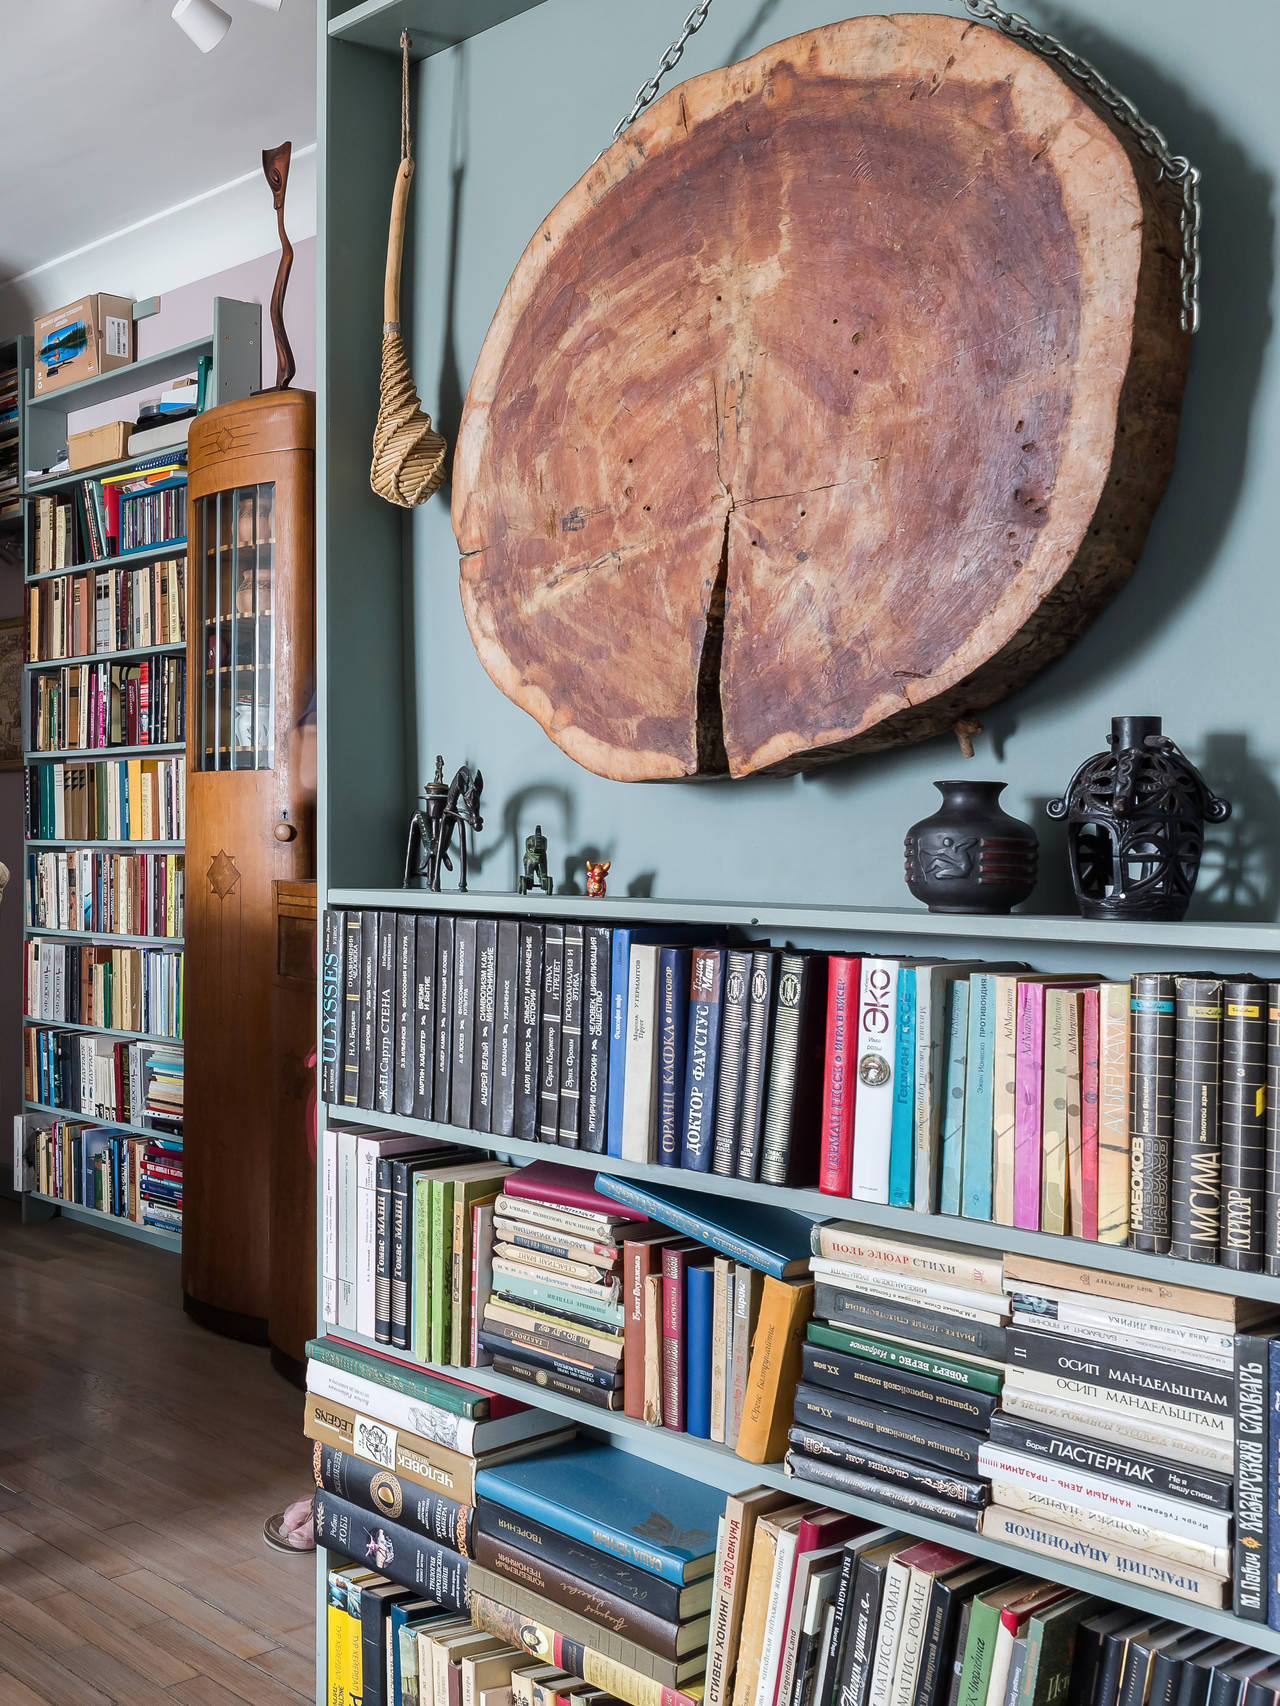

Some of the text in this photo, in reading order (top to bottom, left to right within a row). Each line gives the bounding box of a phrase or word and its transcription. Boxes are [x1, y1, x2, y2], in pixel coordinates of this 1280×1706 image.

[525, 935, 533, 987] НАЗНАЧЕНИЕ
[545, 964, 553, 993] СТРАХ
[552, 958, 560, 992] ТРЕПЕТ
[693, 957, 704, 992] Томас
[701, 957, 713, 992] Манн
[322, 952, 339, 1063] ULYSSES
[479, 950, 488, 1022] СИМВОЛИЗМ КАК
[486, 946, 494, 1023] МИРОПОНИМАНИЕ
[565, 957, 574, 1022] ПСИХОАНАЛИЗ
[572, 972, 580, 1001] ЭТИКА
[589, 936, 598, 1036] ЧЕЛОВЕК ЦИВИЛИЗАЦИЯ
[665, 966, 673, 1015] ПРИГОВОР
[862, 968, 891, 1035] ЭКО
[380, 988, 391, 1034] СТЕНА
[595, 990, 603, 1037] ОБЩЕСТВО
[613, 1009, 623, 1041] Философия
[833, 978, 846, 1053] ИГРА В БИСЕР
[978, 977, 988, 1039] ПРОТИВОЯДИЯ
[480, 1041, 489, 1106] АНДРЕЙ БЕЛЫЙ
[524, 1041, 532, 1073] ЯСПЕРС
[565, 1038, 576, 1088] Эрих Фромм
[897, 1047, 911, 1105] Герман
[976, 1042, 986, 1094] Эжен Ионеско
[418, 1068, 426, 1096] МАРТИН
[588, 1053, 598, 1133] ПИТИРИМ СОРОКИН
[662, 1024, 675, 1153] ФРАНЦ КАФКА
[686, 1005, 709, 1156] ДОКТОР ФАУСТУС
[826, 1066, 845, 1175] ГЕРМАН ГЕССЕ
[1199, 1084, 1208, 1142] Золотой храм
[395, 1174, 403, 1184] 2
[1130, 1137, 1145, 1231] НАБОКОВ
[1190, 1152, 1221, 1241] МИСИМА
[375, 1197, 386, 1236] МАНН
[394, 1199, 404, 1240] МАНН
[1226, 1190, 1252, 1250] КОРТАСАР
[831, 1242, 957, 1275] ПОЛЬ ЭЛЮАР СТИХИ
[631, 1255, 643, 1321] Булат Окуджава
[844, 1303, 976, 1343] РИЛЬКЕ НОВЫЕ СТИХОТВОРЕНИЯ
[1072, 1326, 1118, 1342] БАЛЬМОНТ
[1107, 1315, 1210, 1344] Анна Ахматова ЛИРИКА
[812, 1360, 827, 1371] век
[849, 1340, 969, 1383] РОБЕРТ БЕРНС Избранное
[1056, 1356, 1229, 1408] ОСИП МАНДЕЛЬШТАМ
[806, 1403, 821, 1413] век
[853, 1372, 980, 1416] Страницы европейской поэзии
[1055, 1378, 1226, 1432] ОСИП МАНДЕЛЬШТАМ
[314, 1407, 354, 1436] LEGENS
[846, 1415, 971, 1461] Страницы европейской поэзии
[396, 1453, 455, 1489] ЧЕЛОВЕК
[868, 1460, 910, 1480] СИМФОНИЯ
[1025, 1439, 1156, 1484] Борис ПАСТЕРНАК
[1237, 1362, 1263, 1534] ХАЗАРСКИЙ СЛОВАРЬ
[999, 1462, 1210, 1531] Игорь Губерман КАЖДЫЙ ДЕНЬ ПРАЗДНИК
[1167, 1473, 1181, 1483] Не
[1167, 1482, 1190, 1496] пишу
[330, 1513, 340, 1538] Робин
[338, 1514, 349, 1545] ХОББ
[434, 1500, 444, 1540] ХРОНИКИ
[498, 1518, 544, 1546] ТВОРЕНИЯ
[1028, 1492, 1150, 1538] ХРОНИКИ НАРНИИ
[435, 1550, 444, 1597] КОРОЛЕВСКОМ
[497, 1552, 542, 1580] ТРЕНОЖНИК
[592, 1530, 663, 1572] САША ЧЕРНЫЙ
[722, 1519, 741, 1590] за 30 секунд
[1004, 1520, 1199, 1593] ИРАКЛИЙ АНДРОНИКОВ
[441, 1565, 449, 1594] УБИЙЦЕ
[495, 1560, 545, 1589] КОЛЕБЛЕМЫЙ
[833, 1556, 852, 1622] RENÉ MAGRITTE
[760, 1548, 786, 1682] КИТАЙСКАЯ ПЕЙЗАЖНАЯ ЖИВОПИСЬ
[883, 1576, 903, 1631] РОМАН
[907, 1582, 927, 1638] РОМАН
[931, 1606, 944, 1643] живописи
[708, 1595, 730, 1704] СТИВЕН ХОКИНГ
[781, 1628, 798, 1696] Legendary Land
